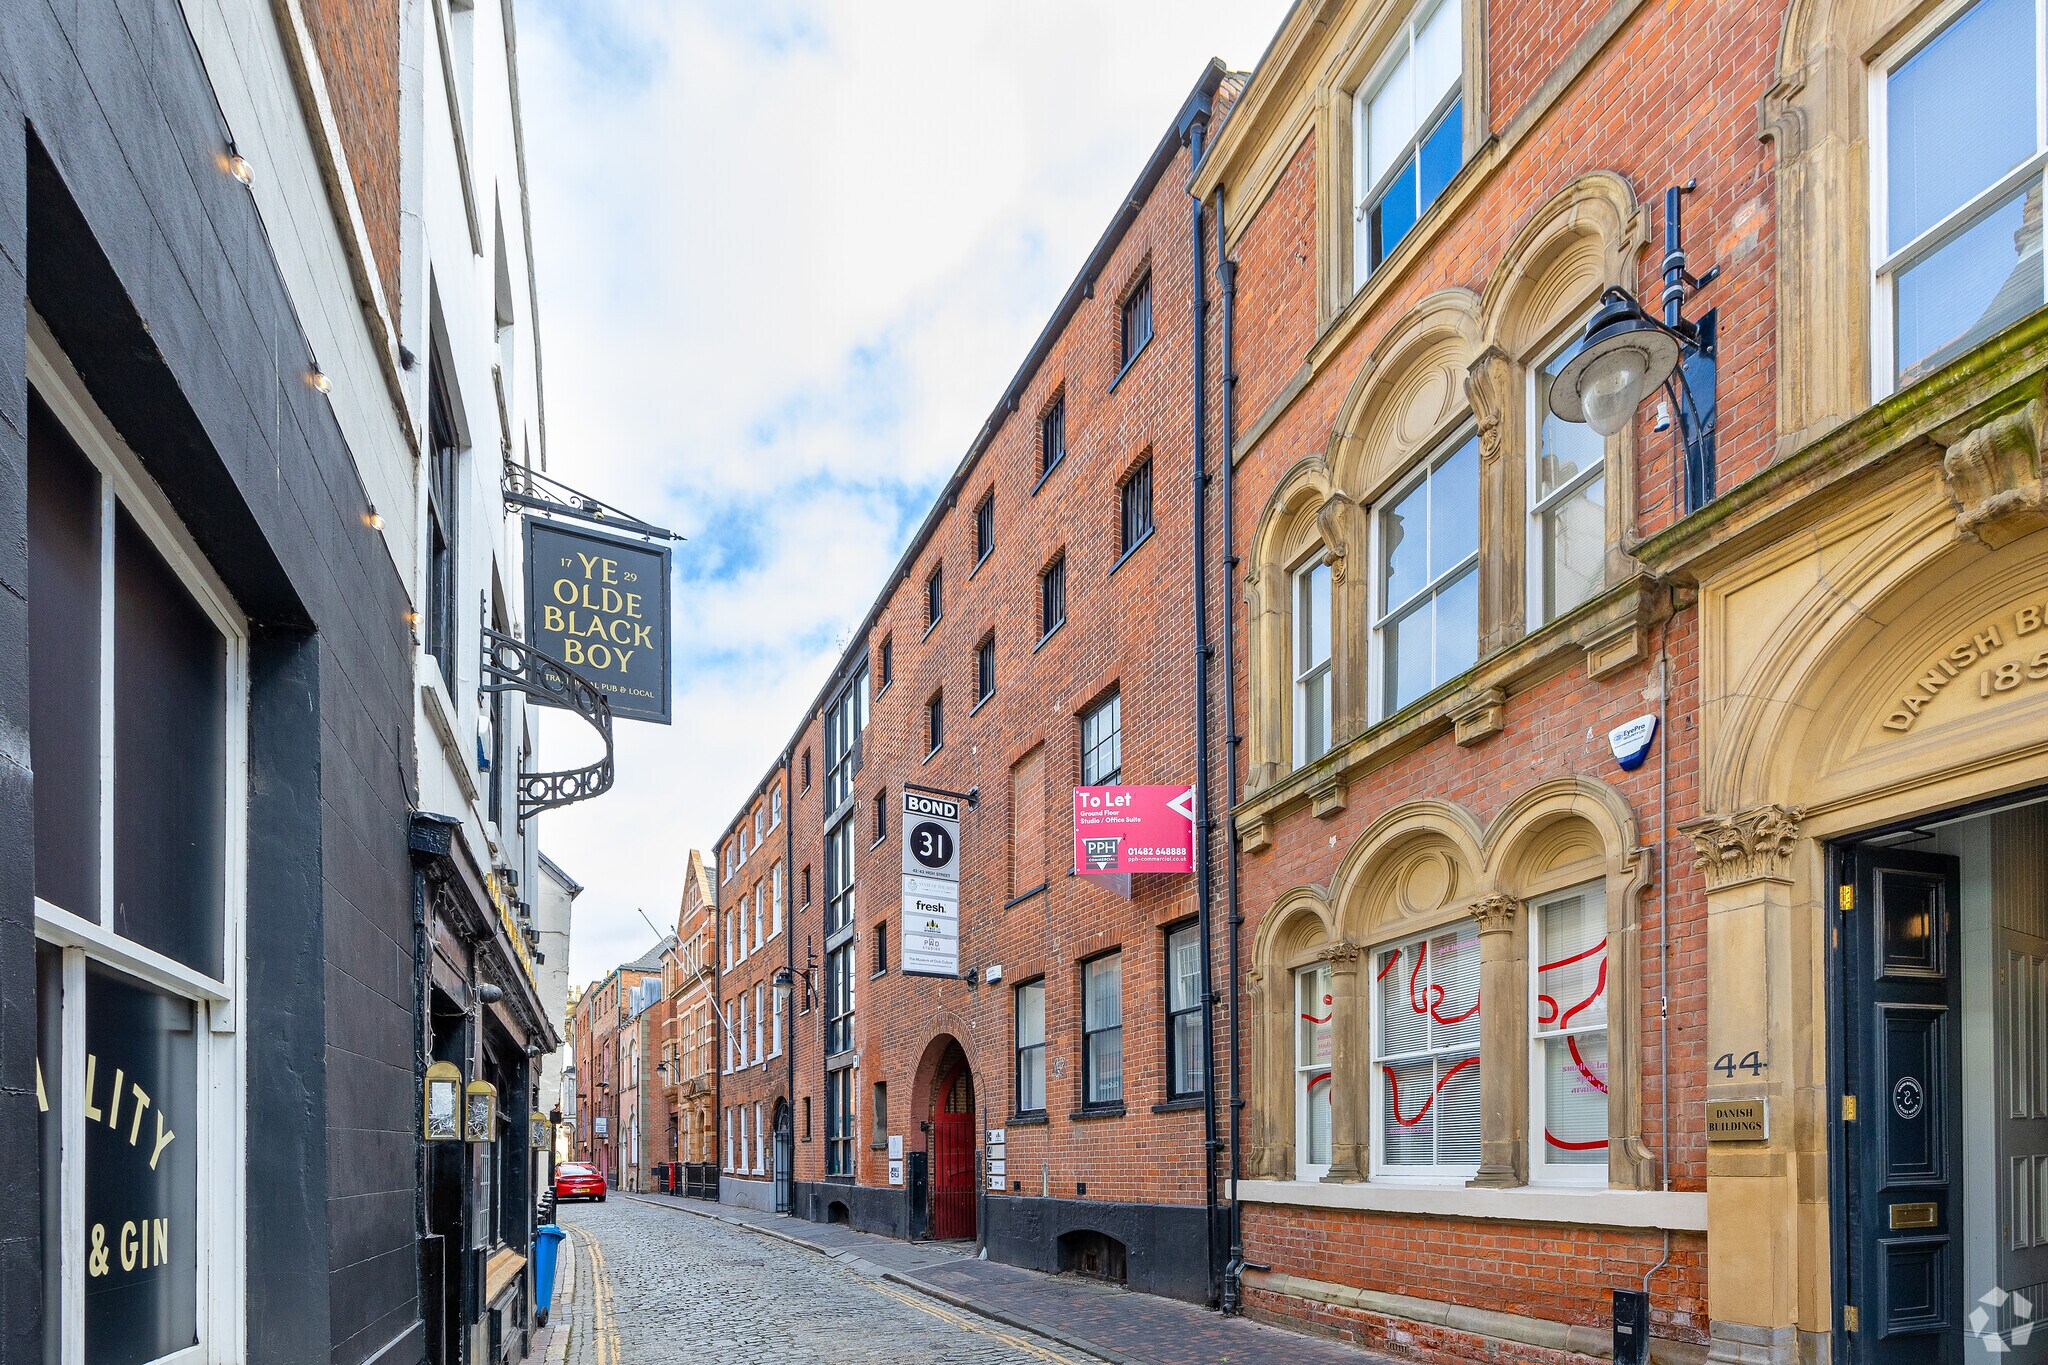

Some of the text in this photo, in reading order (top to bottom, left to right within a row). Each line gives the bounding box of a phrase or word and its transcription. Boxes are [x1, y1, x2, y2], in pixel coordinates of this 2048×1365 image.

[560, 552, 638, 585] 17 YE 29
[553, 578, 642, 619] OLDE
[543, 605, 654, 650] BLACK
[564, 638, 634, 673] BOY
[601, 683, 618, 692] PUB
[620, 686, 627, 694] &
[628, 688, 655, 699] LOCAL
[1882, 623, 2004, 732] DANISH
[908, 796, 956, 817] BOND
[1079, 792, 1132, 807] To Let
[919, 831, 943, 860] 31
[1088, 841, 1116, 854] PPH
[1127, 847, 1187, 856] 01482 648888
[1713, 1051, 1763, 1078] 44
[1709, 1121, 1762, 1131] BUILDINGS
[1716, 1108, 1753, 1118] DANISH
[89, 1217, 168, 1277] & GIN
